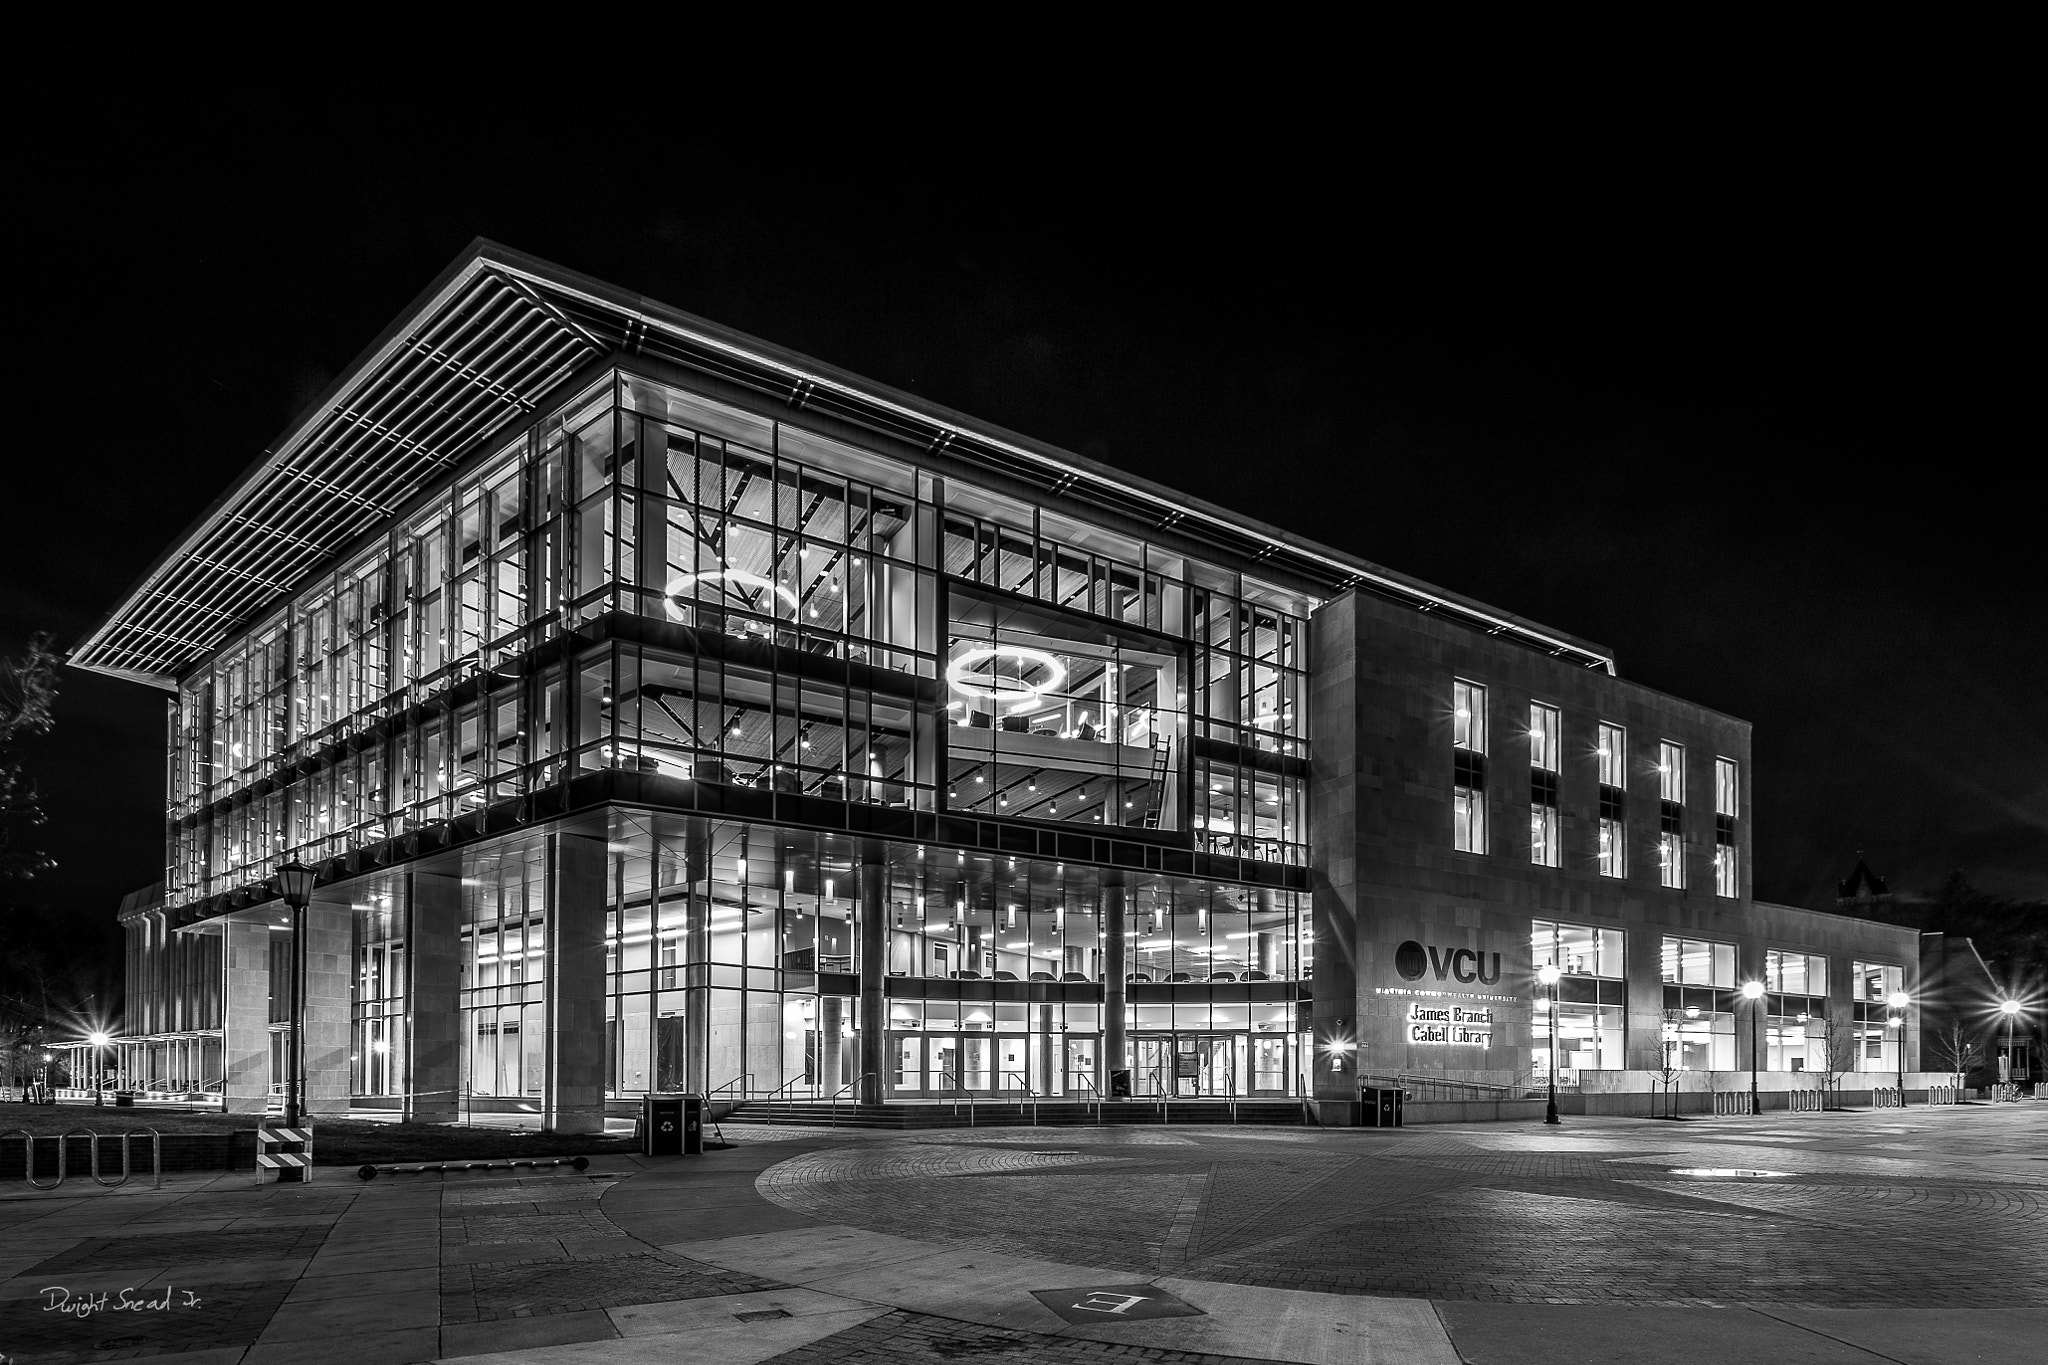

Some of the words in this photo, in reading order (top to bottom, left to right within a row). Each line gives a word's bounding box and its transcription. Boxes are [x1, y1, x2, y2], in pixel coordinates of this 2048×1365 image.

[1427, 945, 1501, 986] VCU
[1409, 1003, 1450, 1022] James
[1451, 1006, 1494, 1024] Branch
[1410, 1025, 1449, 1043] Cabell
[1451, 1027, 1494, 1048] Library
